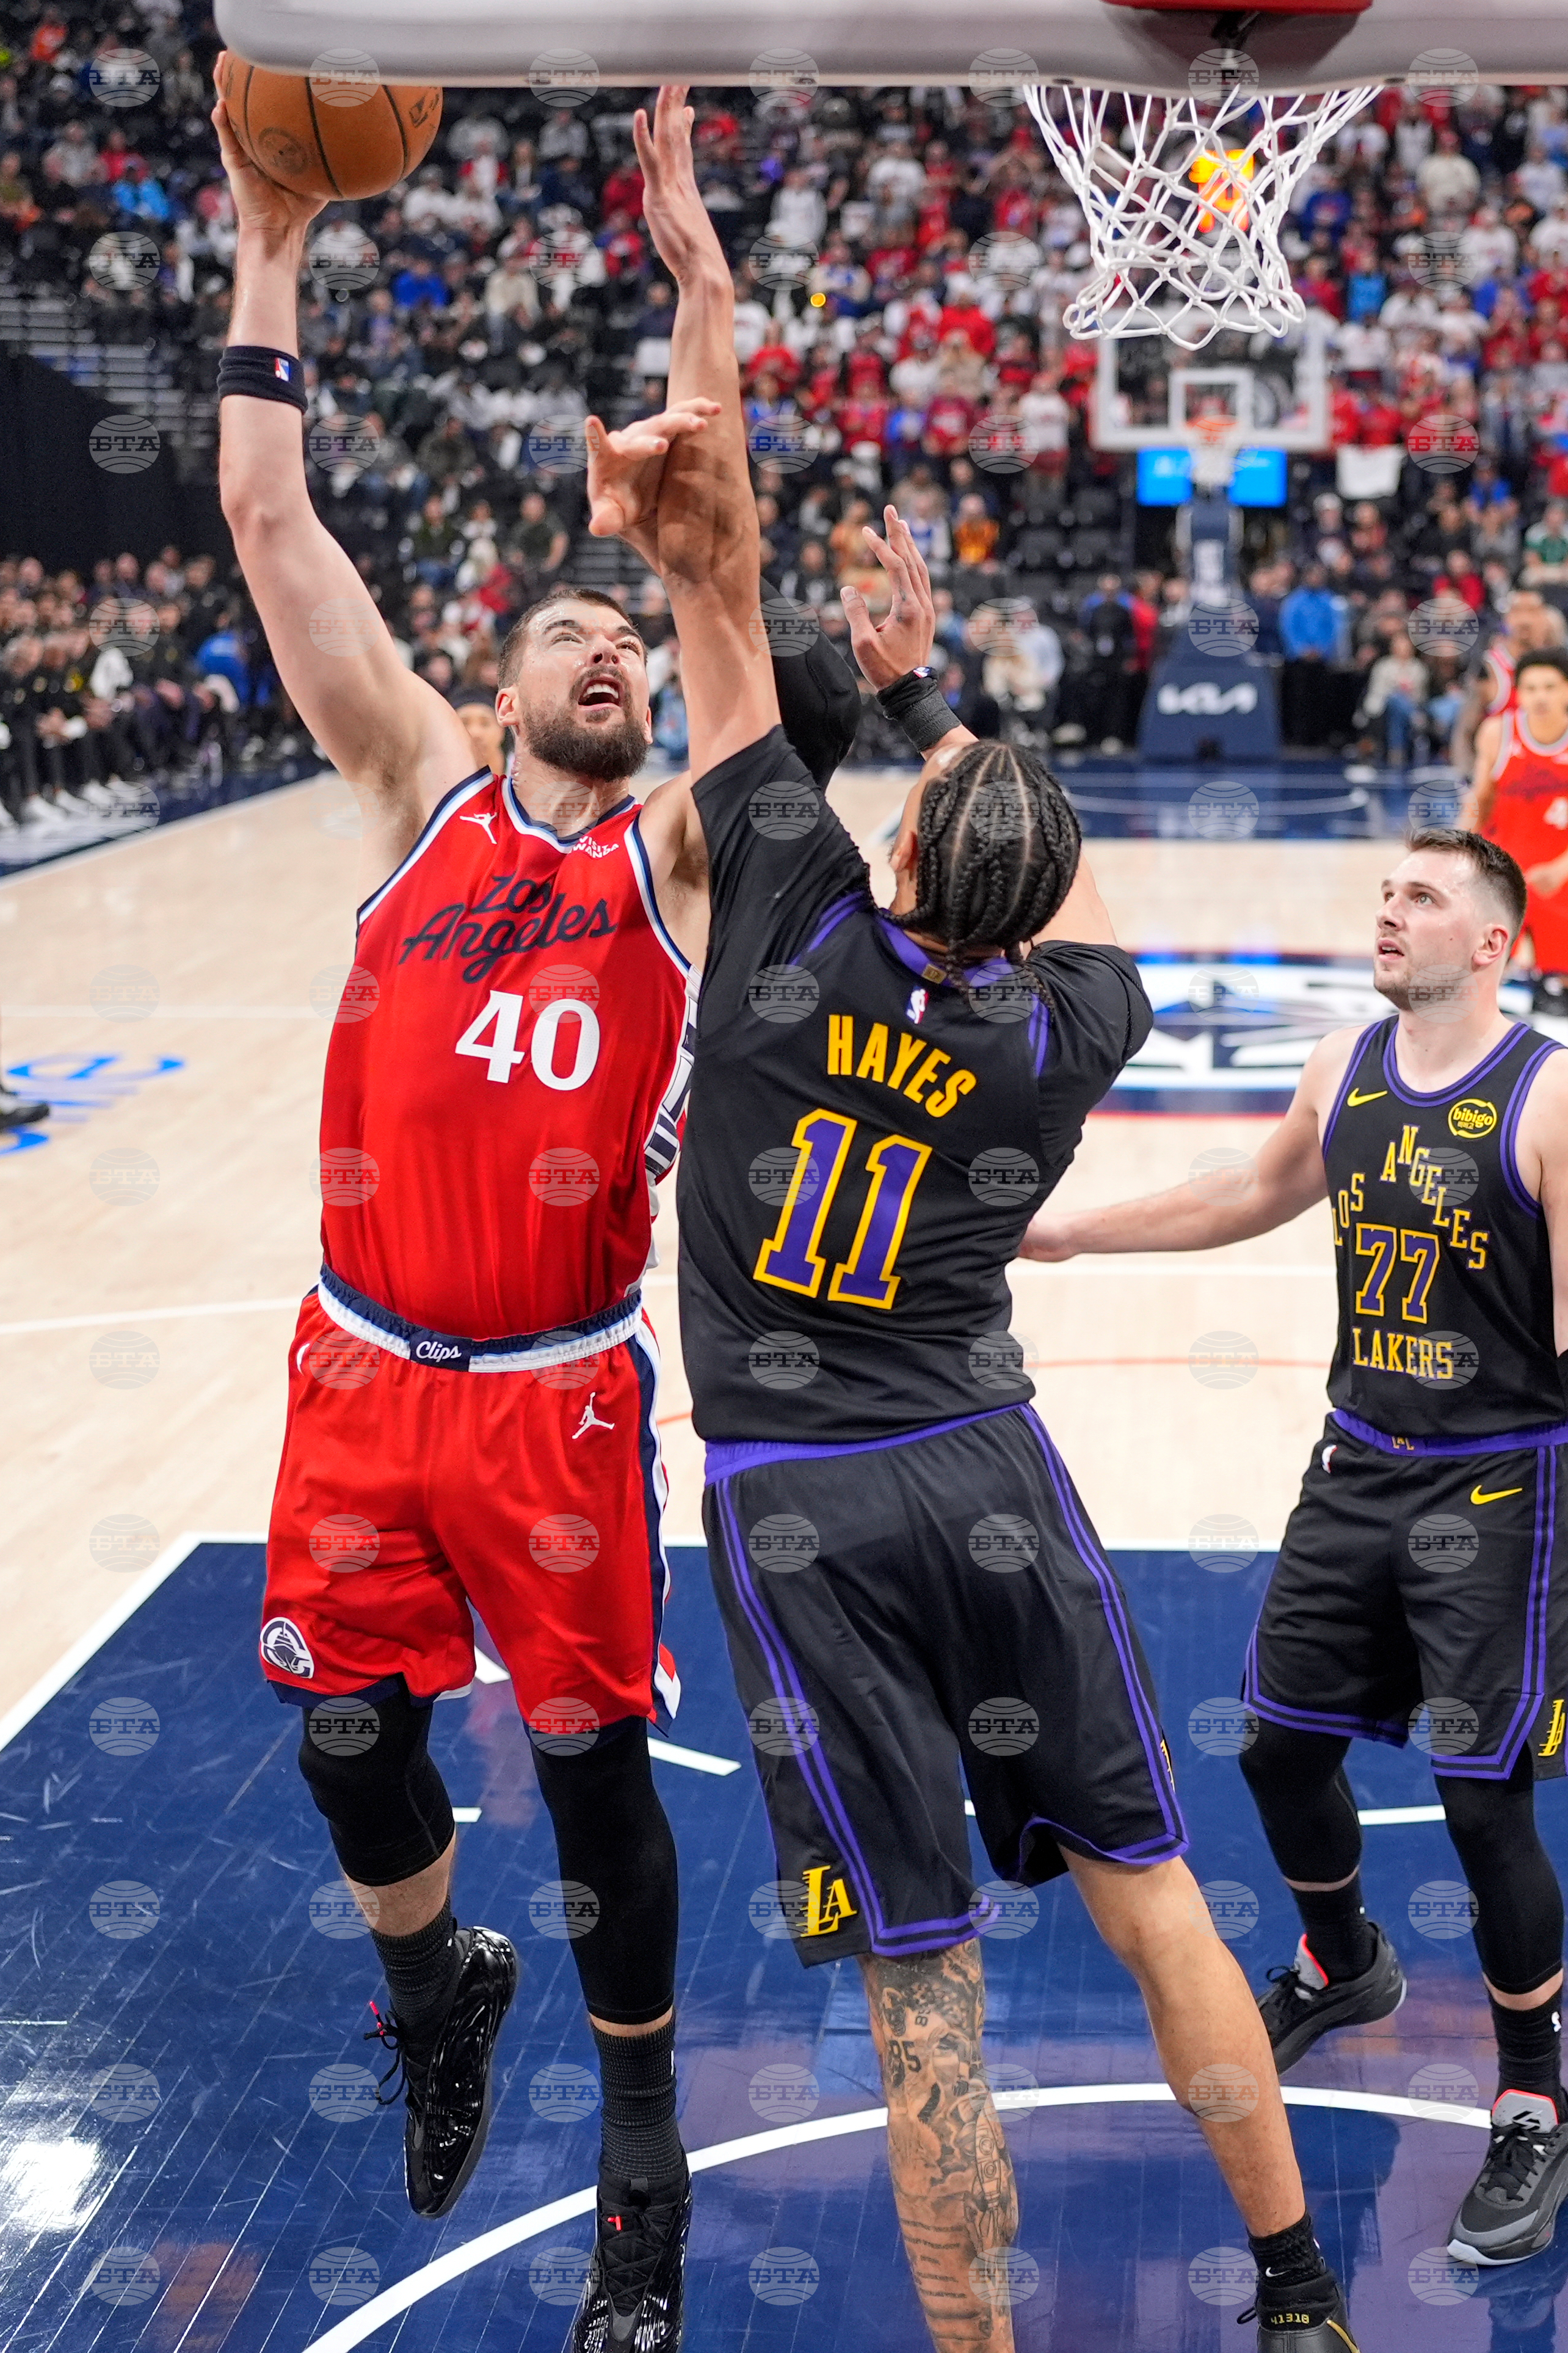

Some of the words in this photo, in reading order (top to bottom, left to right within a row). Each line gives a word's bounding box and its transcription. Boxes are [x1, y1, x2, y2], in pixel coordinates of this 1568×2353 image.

[398, 893, 618, 984] Angeles
[471, 872, 554, 914] Los
[455, 990, 600, 1091] 40
[827, 1014, 976, 1118] HAYES
[1453, 1107, 1494, 1129] bibigo
[753, 1108, 932, 1309] 11
[1333, 1173, 1365, 1246] LOS
[1380, 1124, 1489, 1270] ANGELES
[1356, 1223, 1440, 1325] 77
[416, 1340, 462, 1362] Clips
[1352, 1327, 1456, 1381] LAKERS
[796, 1864, 857, 1937] LA
